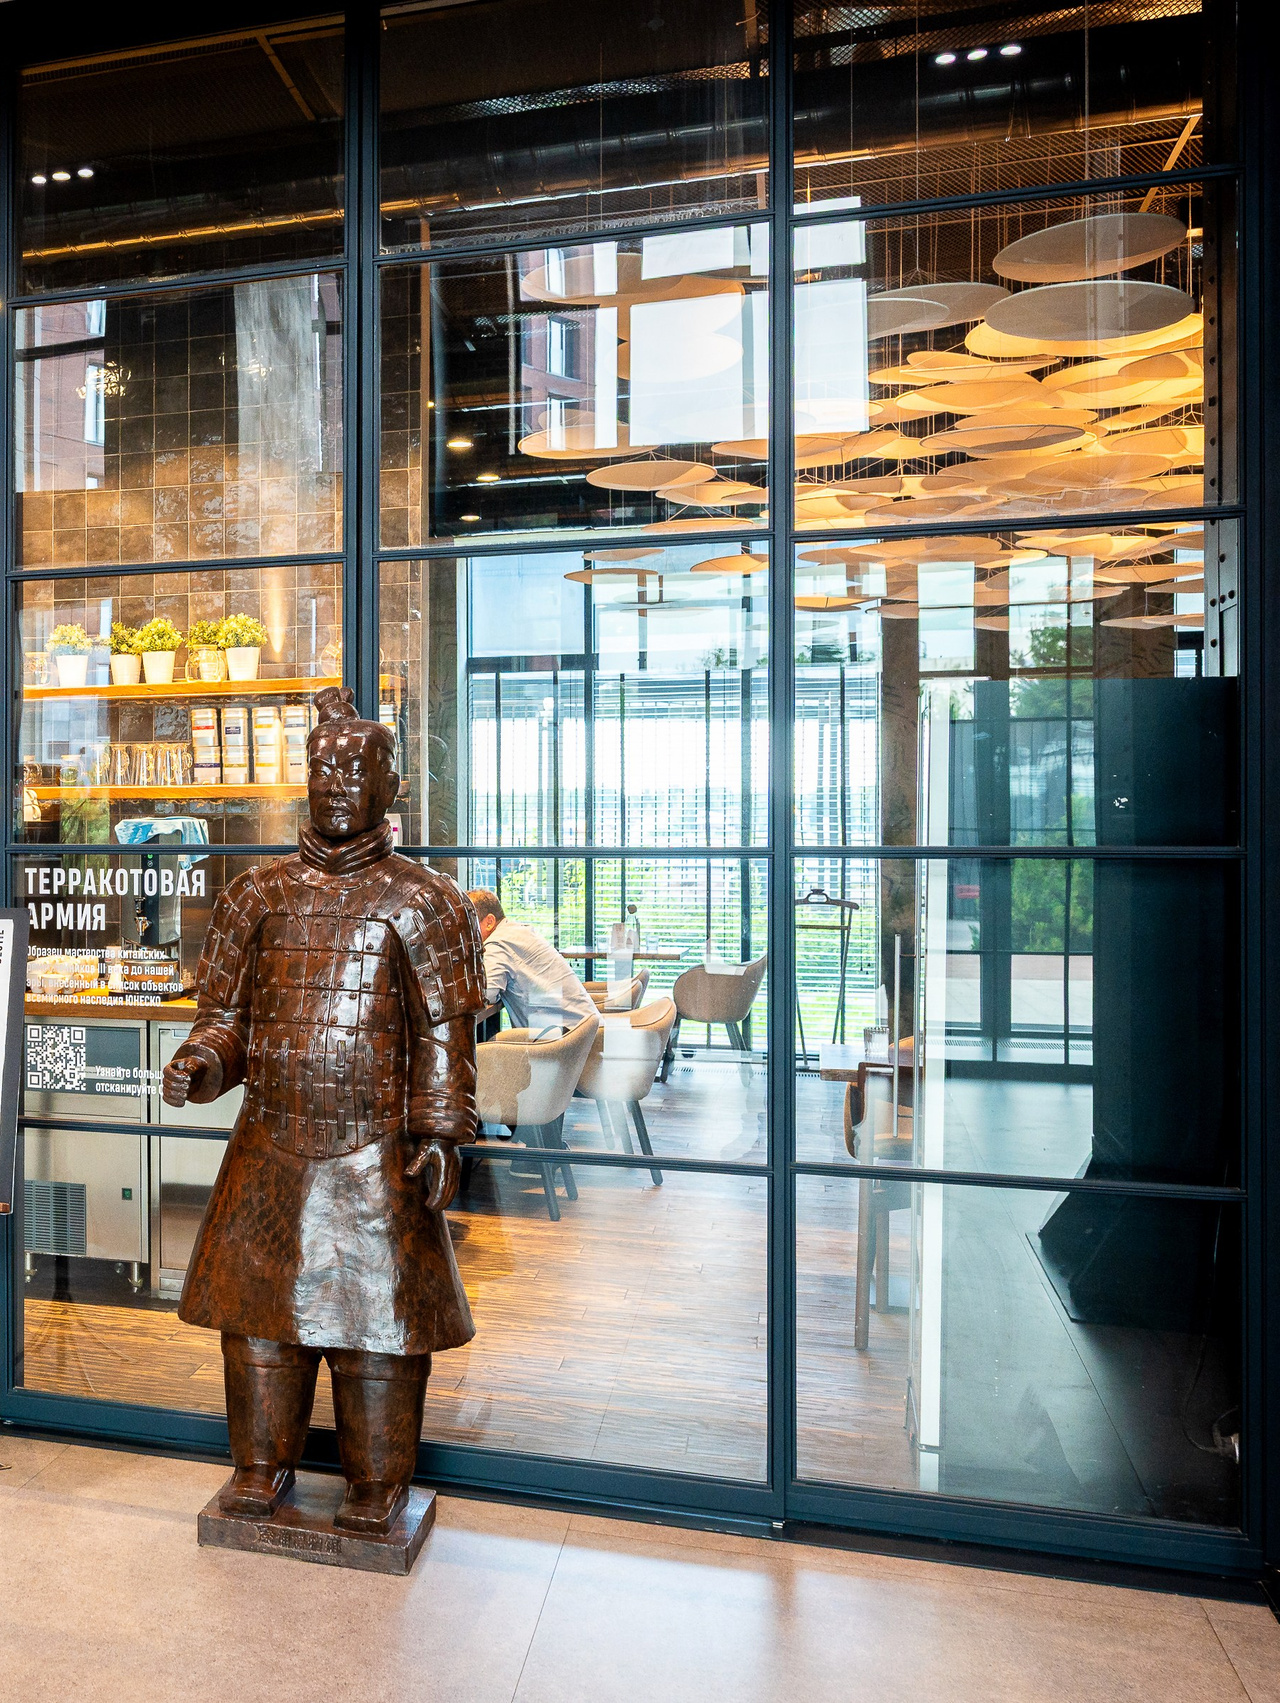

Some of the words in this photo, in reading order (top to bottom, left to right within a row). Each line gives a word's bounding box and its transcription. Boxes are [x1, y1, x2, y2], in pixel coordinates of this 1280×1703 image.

[24, 867, 206, 897] ТЕРРАКОТОВАЯ
[28, 902, 106, 931] АРМИЯ
[64, 948, 116, 959] мастерства
[117, 949, 165, 960] китайских
[131, 965, 143, 976] до
[144, 964, 175, 976] нашей
[50, 978, 99, 989] внесенный
[100, 981, 106, 989] в
[141, 980, 184, 993] объектов
[26, 993, 79, 1006] всемирного
[80, 995, 124, 1007] наследия
[125, 994, 164, 1007] ЮНЕСКО.
[95, 1065, 131, 1078] Узнайте
[132, 1067, 164, 1079] больш
[95, 1082, 157, 1096] отсканируйте
